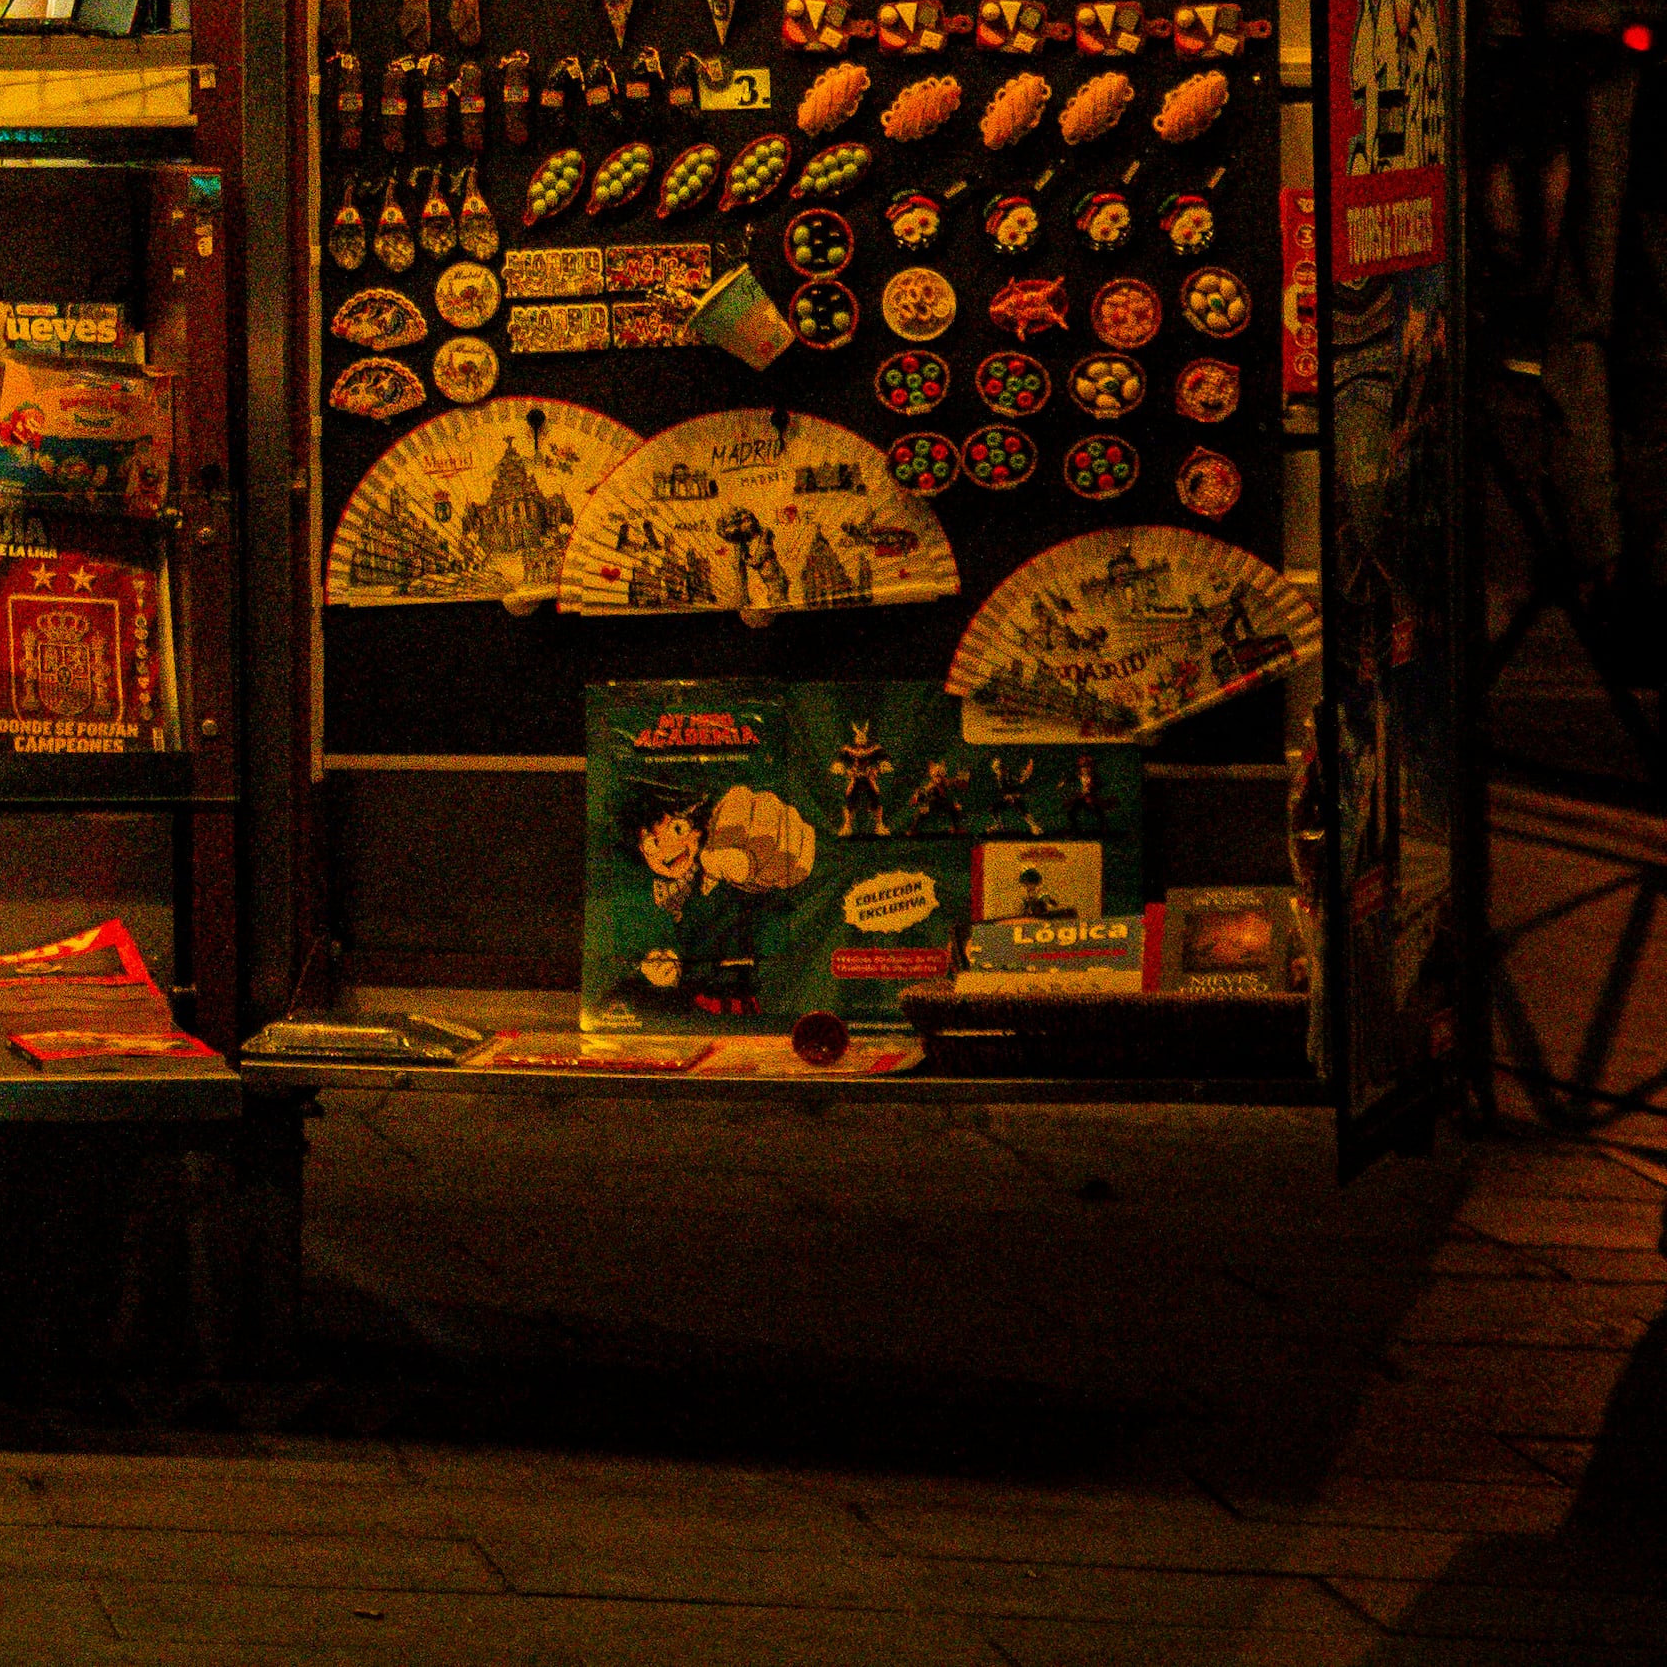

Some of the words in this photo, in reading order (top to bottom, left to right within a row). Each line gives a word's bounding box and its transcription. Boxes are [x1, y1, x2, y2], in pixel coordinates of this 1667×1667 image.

[710, 437, 785, 467] MADRID
[13, 736, 125, 753] CAMPEONES
[855, 881, 922, 907] COLECCIÓN
[858, 896, 927, 921] EXCLUSIVA
[1014, 920, 1129, 951] Lógica
